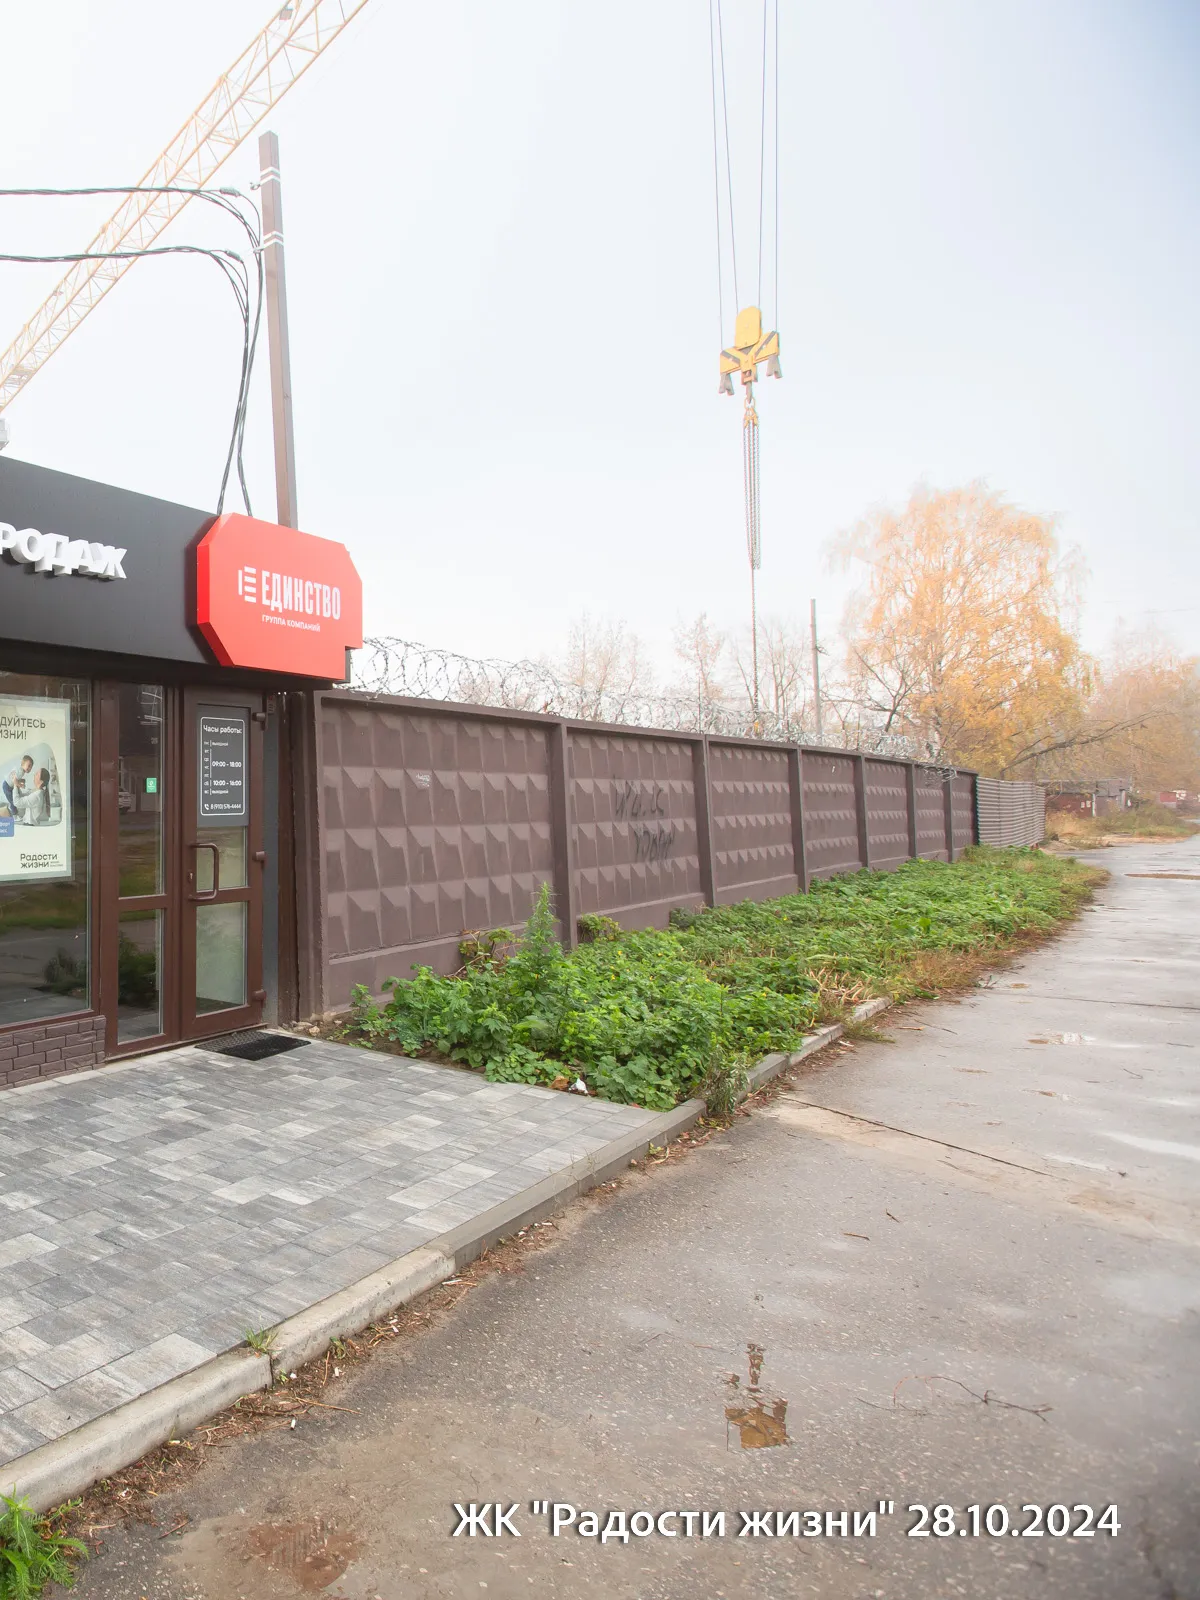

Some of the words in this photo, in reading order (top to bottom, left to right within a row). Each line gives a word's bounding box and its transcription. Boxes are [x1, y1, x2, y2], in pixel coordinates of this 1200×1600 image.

[261, 569, 341, 620] ЕДИНСТВО
[261, 614, 287, 626] ГРУППА
[286, 619, 321, 633] КОМПАНИЙ
[220, 726, 242, 734] работы:
[20, 853, 58, 862] Радости
[20, 861, 50, 869] жизни
